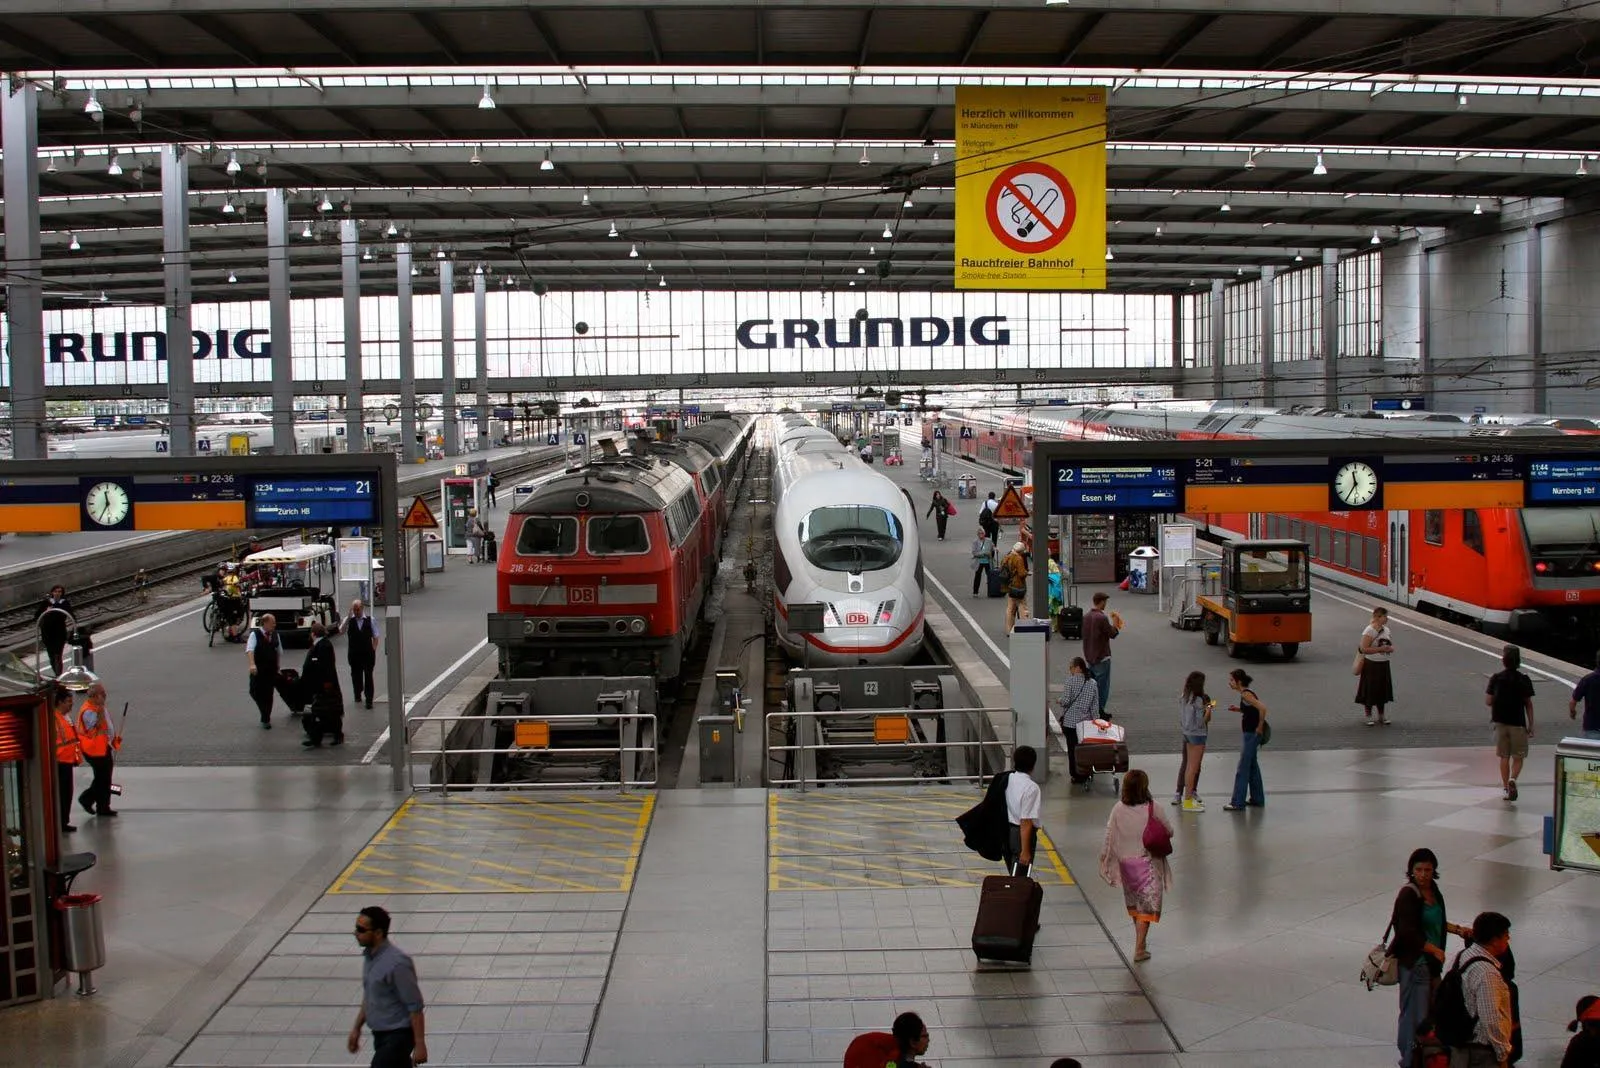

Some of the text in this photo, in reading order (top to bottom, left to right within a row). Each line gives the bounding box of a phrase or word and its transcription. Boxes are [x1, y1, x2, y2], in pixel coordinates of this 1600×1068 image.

[961, 108, 1074, 119] Herzlich willkommen
[961, 258, 1074, 268] Rauchfreier Bahnhof
[737, 316, 1010, 349] GRUNDIG
[1195, 459, 1213, 467] 5-21
[1491, 455, 1513, 463] 24-36
[211, 475, 234, 483] 22-36
[1058, 469, 1074, 481] 22
[356, 481, 370, 493] 21
[1552, 487, 1582, 495] Nürnberg
[510, 564, 523, 573] 218
[571, 588, 593, 602] DB
[847, 614, 867, 623] DB
[867, 683, 876, 692] 22
